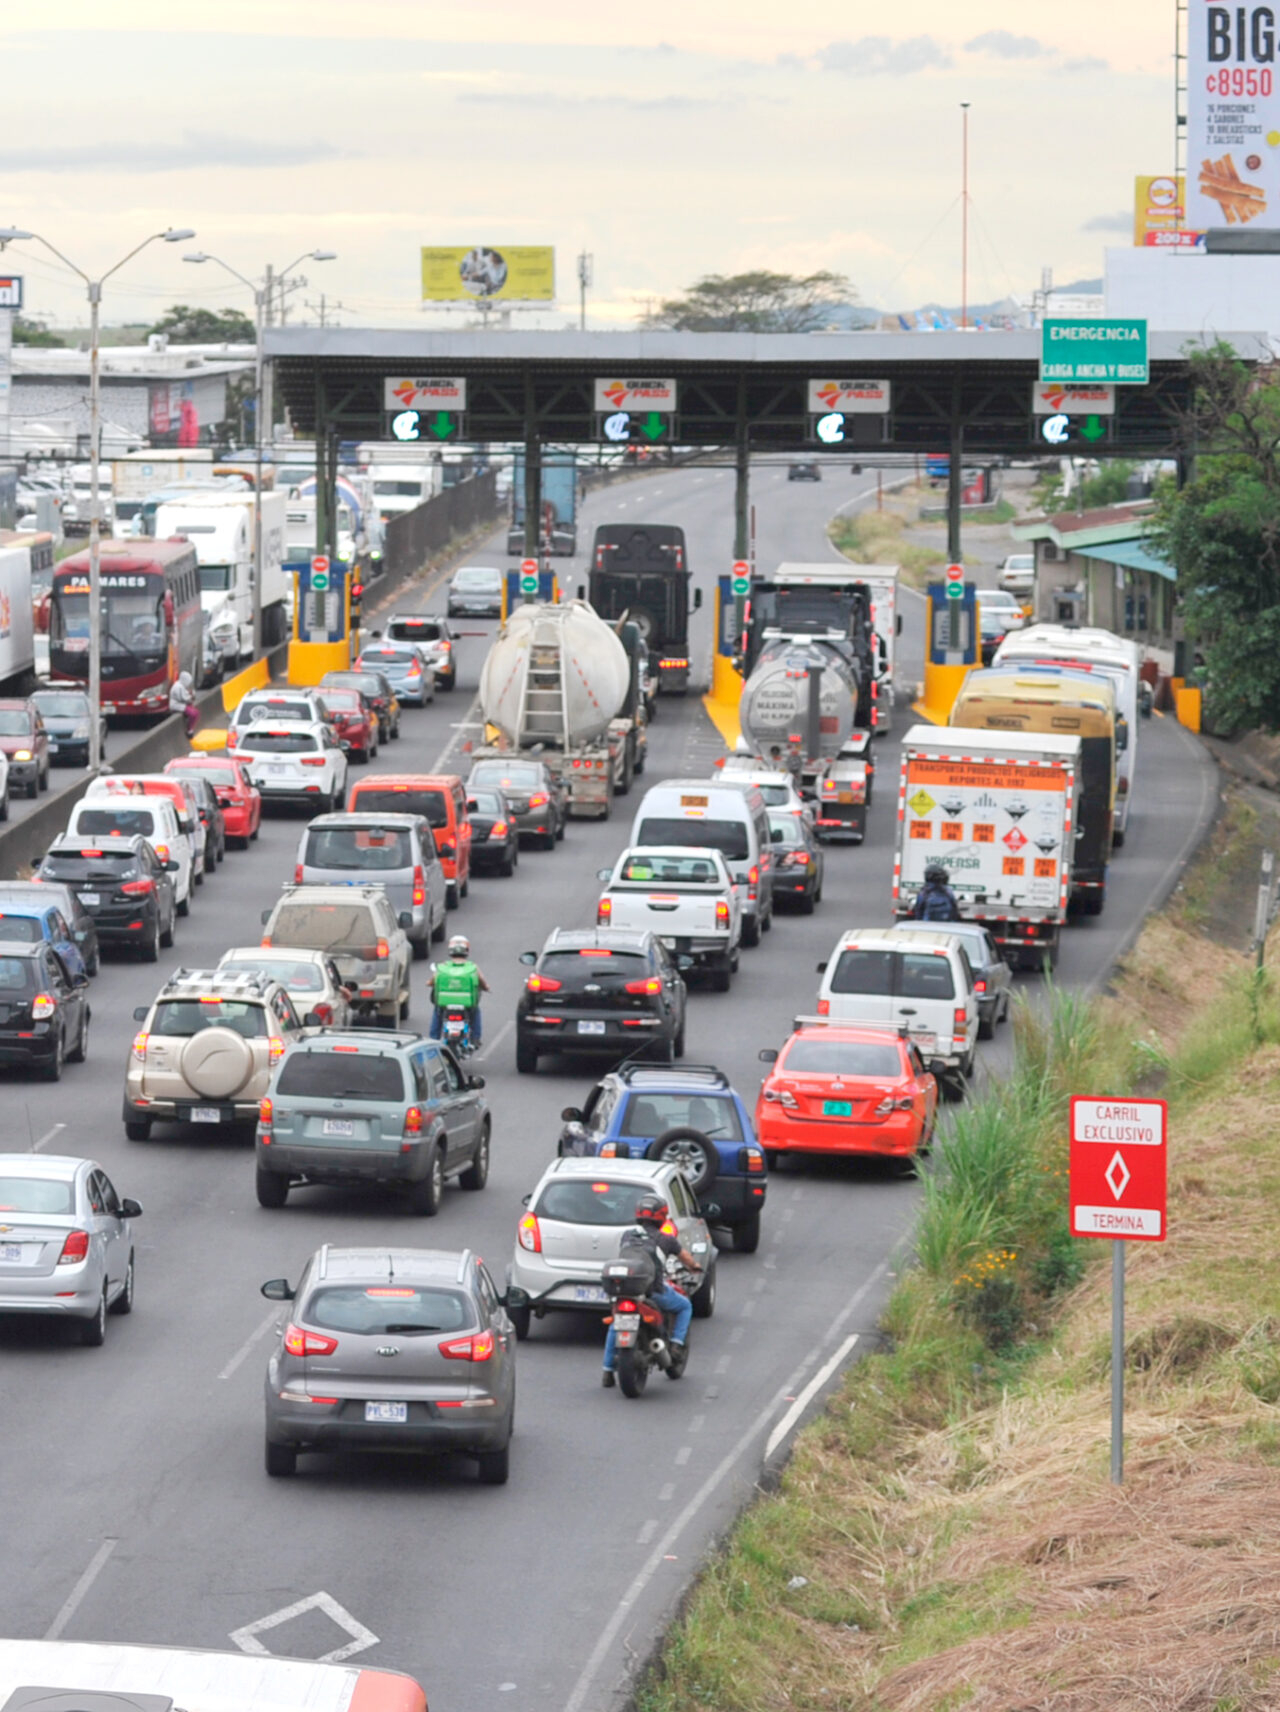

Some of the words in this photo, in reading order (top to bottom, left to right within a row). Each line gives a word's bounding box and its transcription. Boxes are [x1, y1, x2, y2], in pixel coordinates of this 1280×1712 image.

[1207, 7, 1279, 63] BIG
[1050, 327, 1140, 340] EMERGENCIA
[1043, 364, 1073, 377] CARGA
[1076, 364, 1107, 377] ANCHA
[1108, 364, 1115, 377] Y
[1118, 364, 1146, 378] BUSES
[416, 380, 455, 388] QUICK
[626, 381, 666, 389] QUICK
[840, 382, 879, 390] QUICK
[422, 388, 459, 397] PASS
[633, 389, 670, 397] PASS
[846, 390, 883, 399] PASS
[1071, 391, 1109, 400] PASS
[71, 577, 146, 588] PAMARES
[914, 763, 964, 774] TRANSPORTA
[967, 766, 1012, 776] PRODUCTOS
[1015, 768, 1062, 778] PELIGROSOS
[949, 777, 992, 786] REPORTES
[995, 778, 1004, 786] AL
